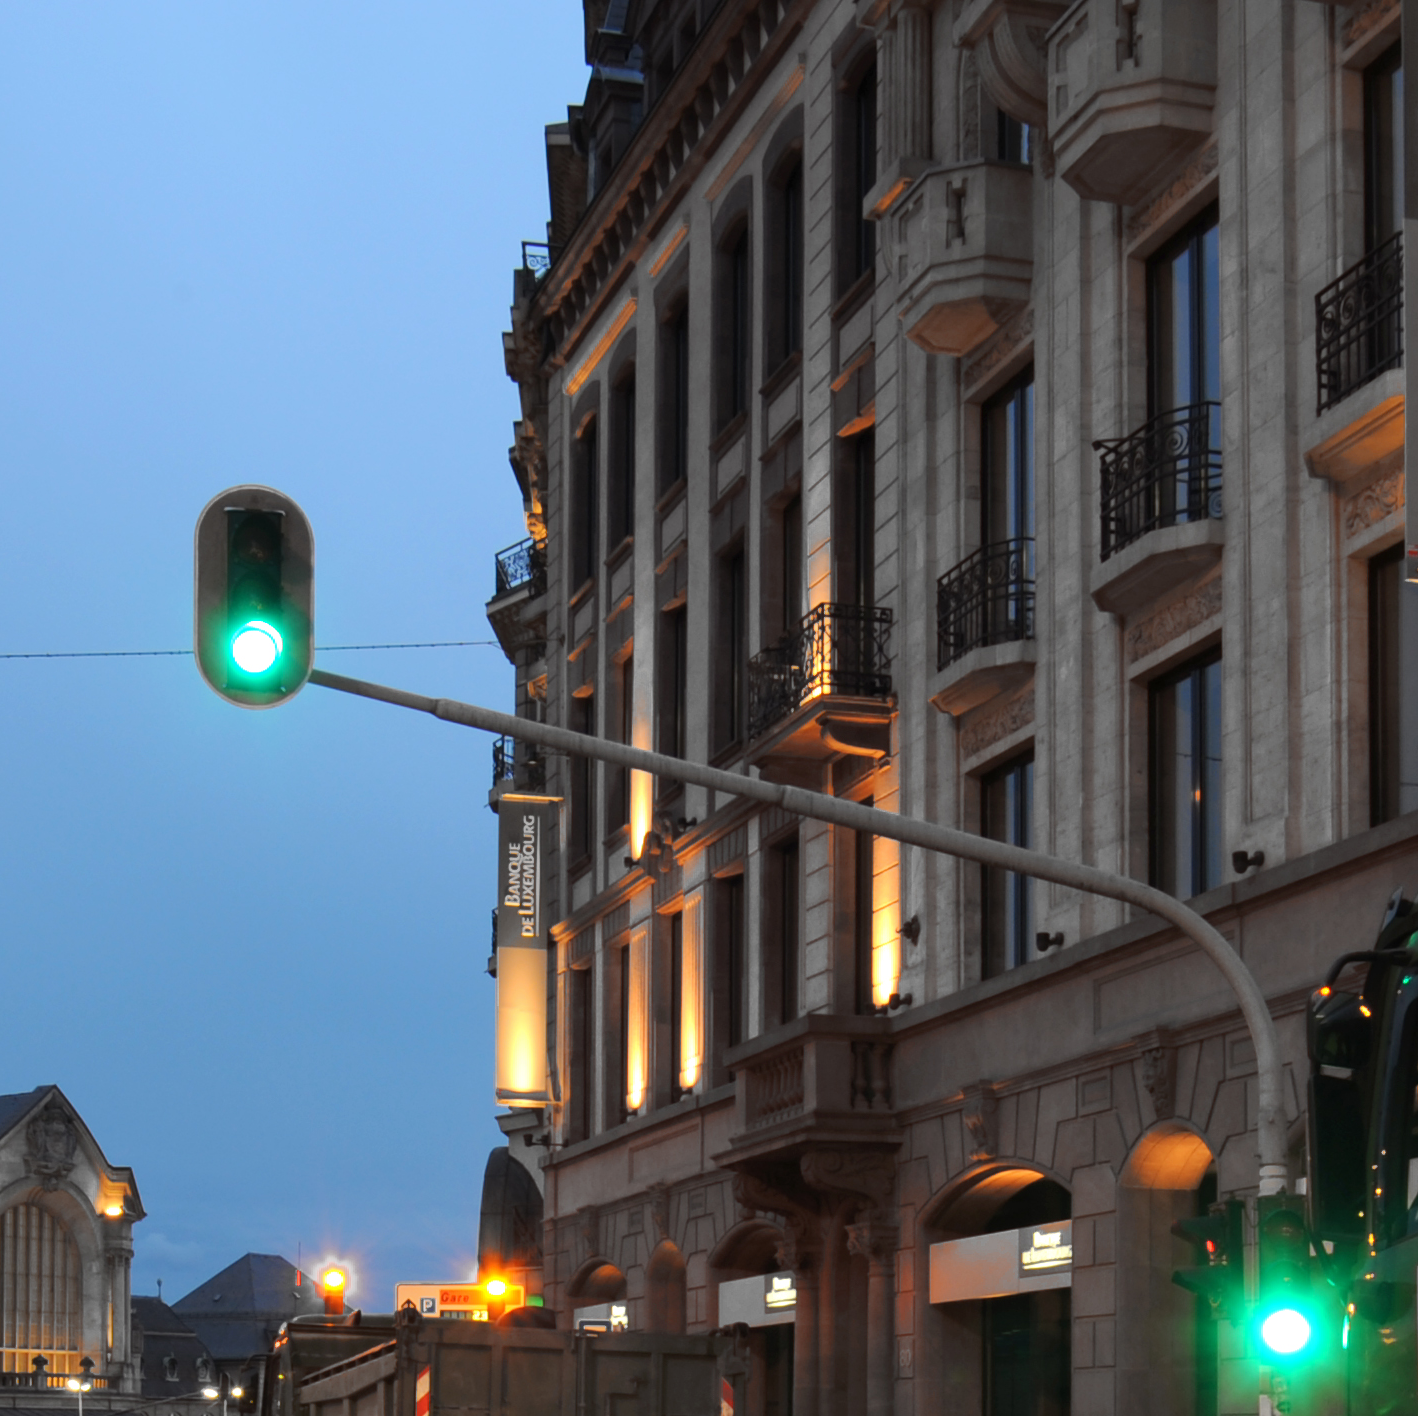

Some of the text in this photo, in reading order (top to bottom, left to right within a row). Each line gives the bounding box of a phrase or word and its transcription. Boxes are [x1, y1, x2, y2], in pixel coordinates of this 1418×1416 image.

[504, 842, 523, 907] BANQUE
[518, 815, 535, 937] DE LUXEMBOURG
[441, 1292, 469, 1303] Gare
